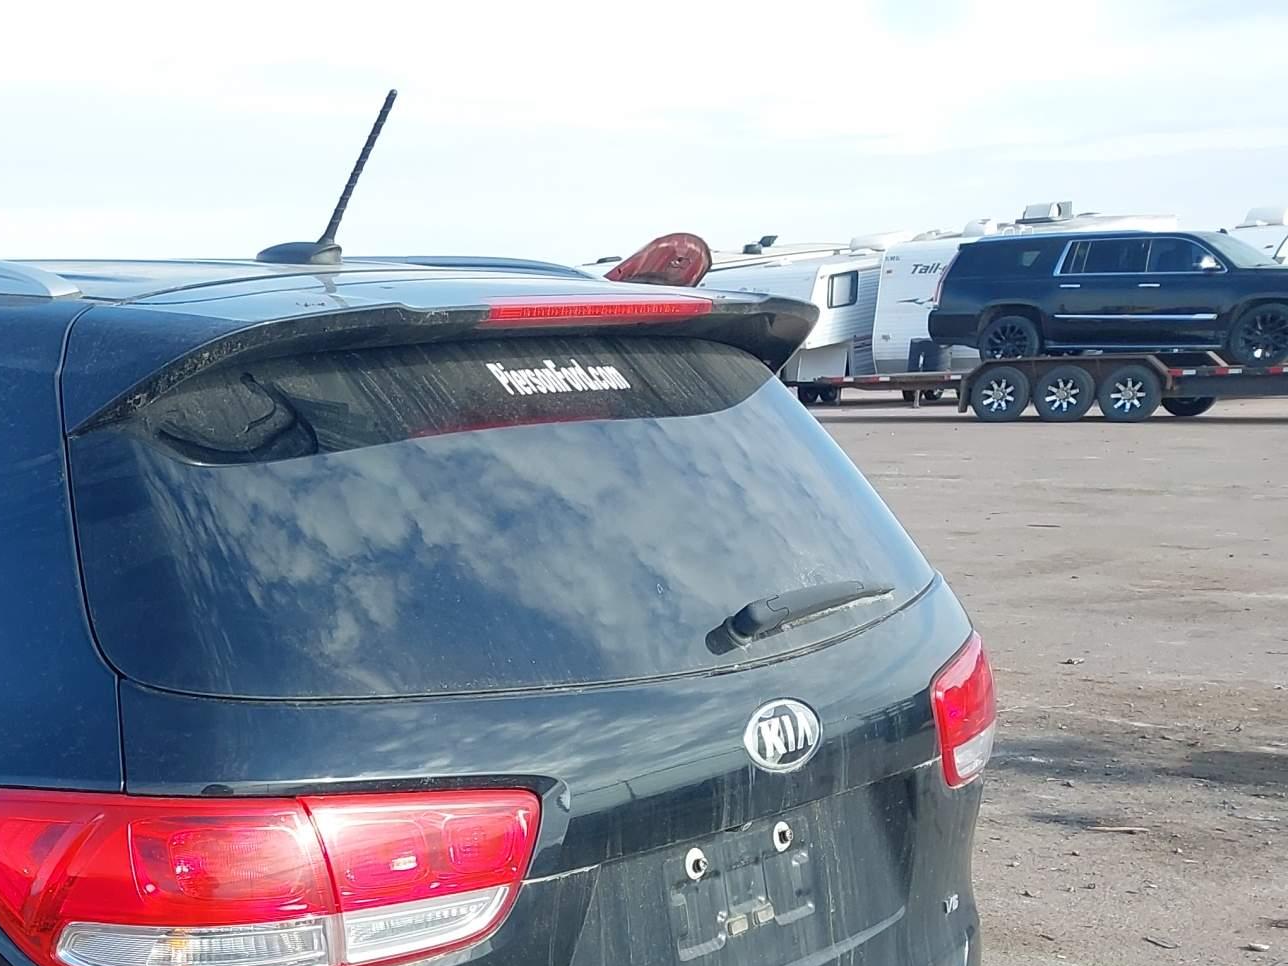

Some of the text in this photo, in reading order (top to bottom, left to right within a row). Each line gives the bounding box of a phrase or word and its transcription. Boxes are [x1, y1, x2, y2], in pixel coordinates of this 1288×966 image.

[485, 358, 631, 396] PiersonFord.com
[758, 711, 814, 759] KIA
[944, 894, 959, 913] V6
